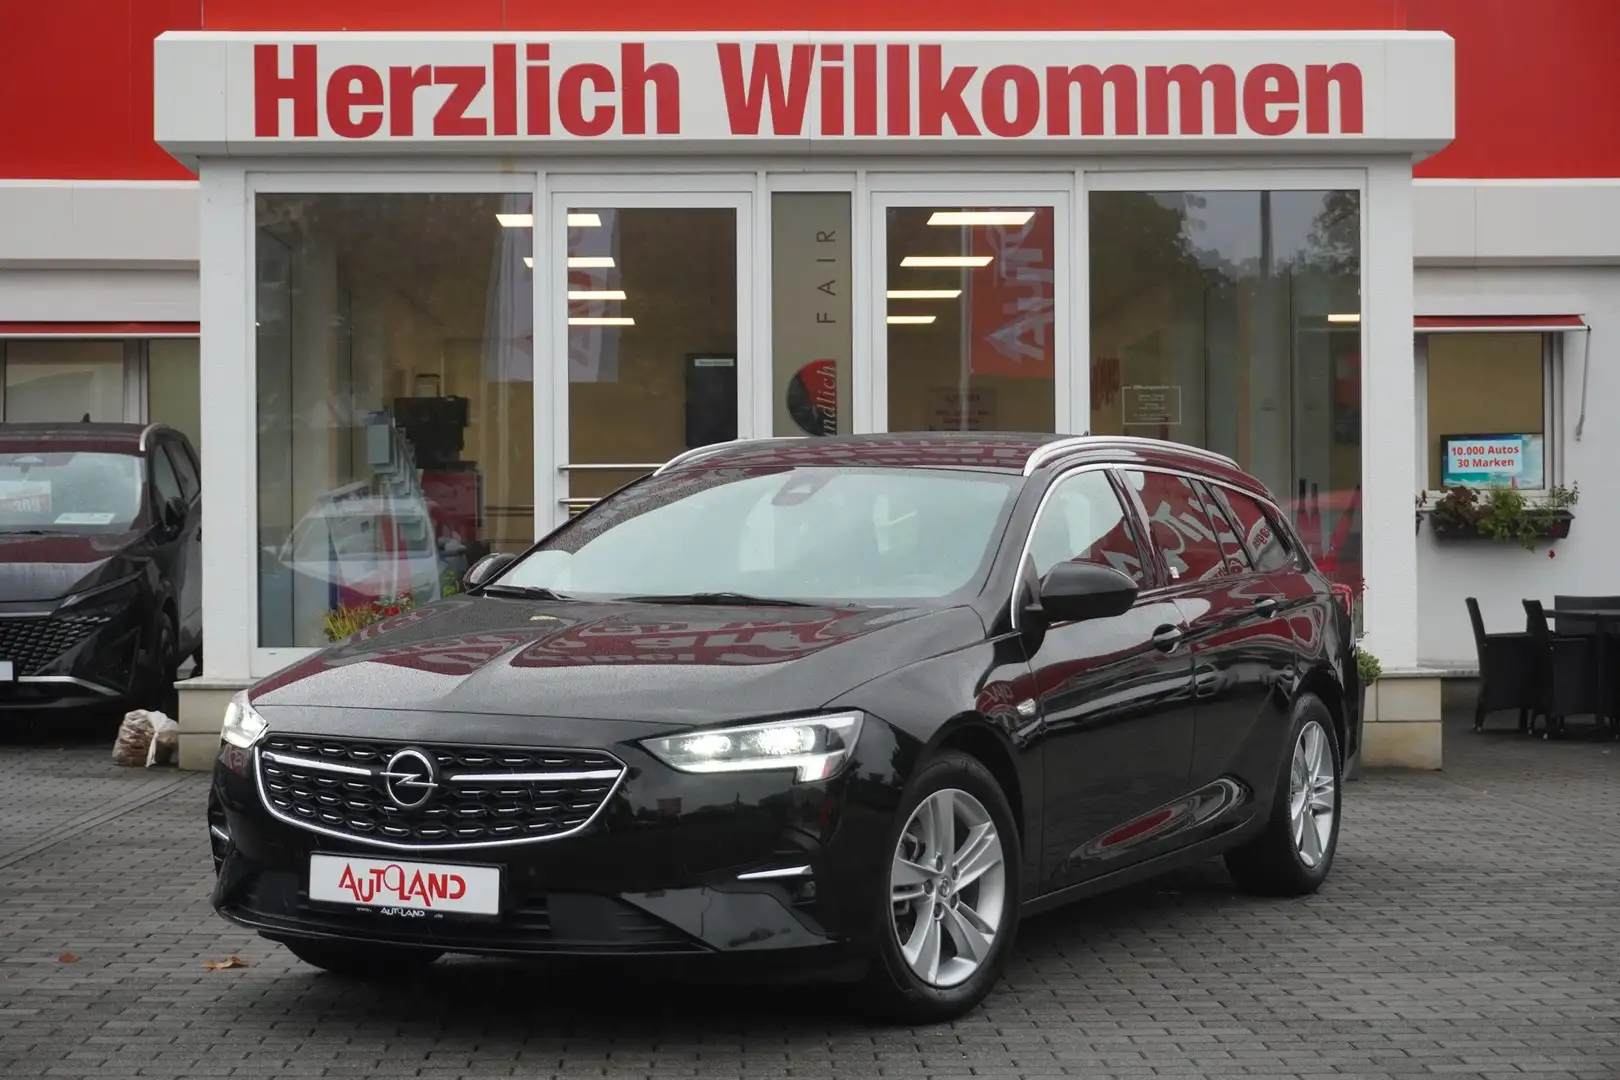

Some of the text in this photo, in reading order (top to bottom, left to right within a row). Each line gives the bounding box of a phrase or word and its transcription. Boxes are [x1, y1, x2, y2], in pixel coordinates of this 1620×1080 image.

[255, 43, 1363, 139] Herzlich Willkommen
[816, 230, 836, 323] FAIR
[1451, 446, 1519, 456] 10.000 Autos
[1457, 458, 1514, 468] 30 Marken
[338, 863, 466, 907] AUTOLAND
